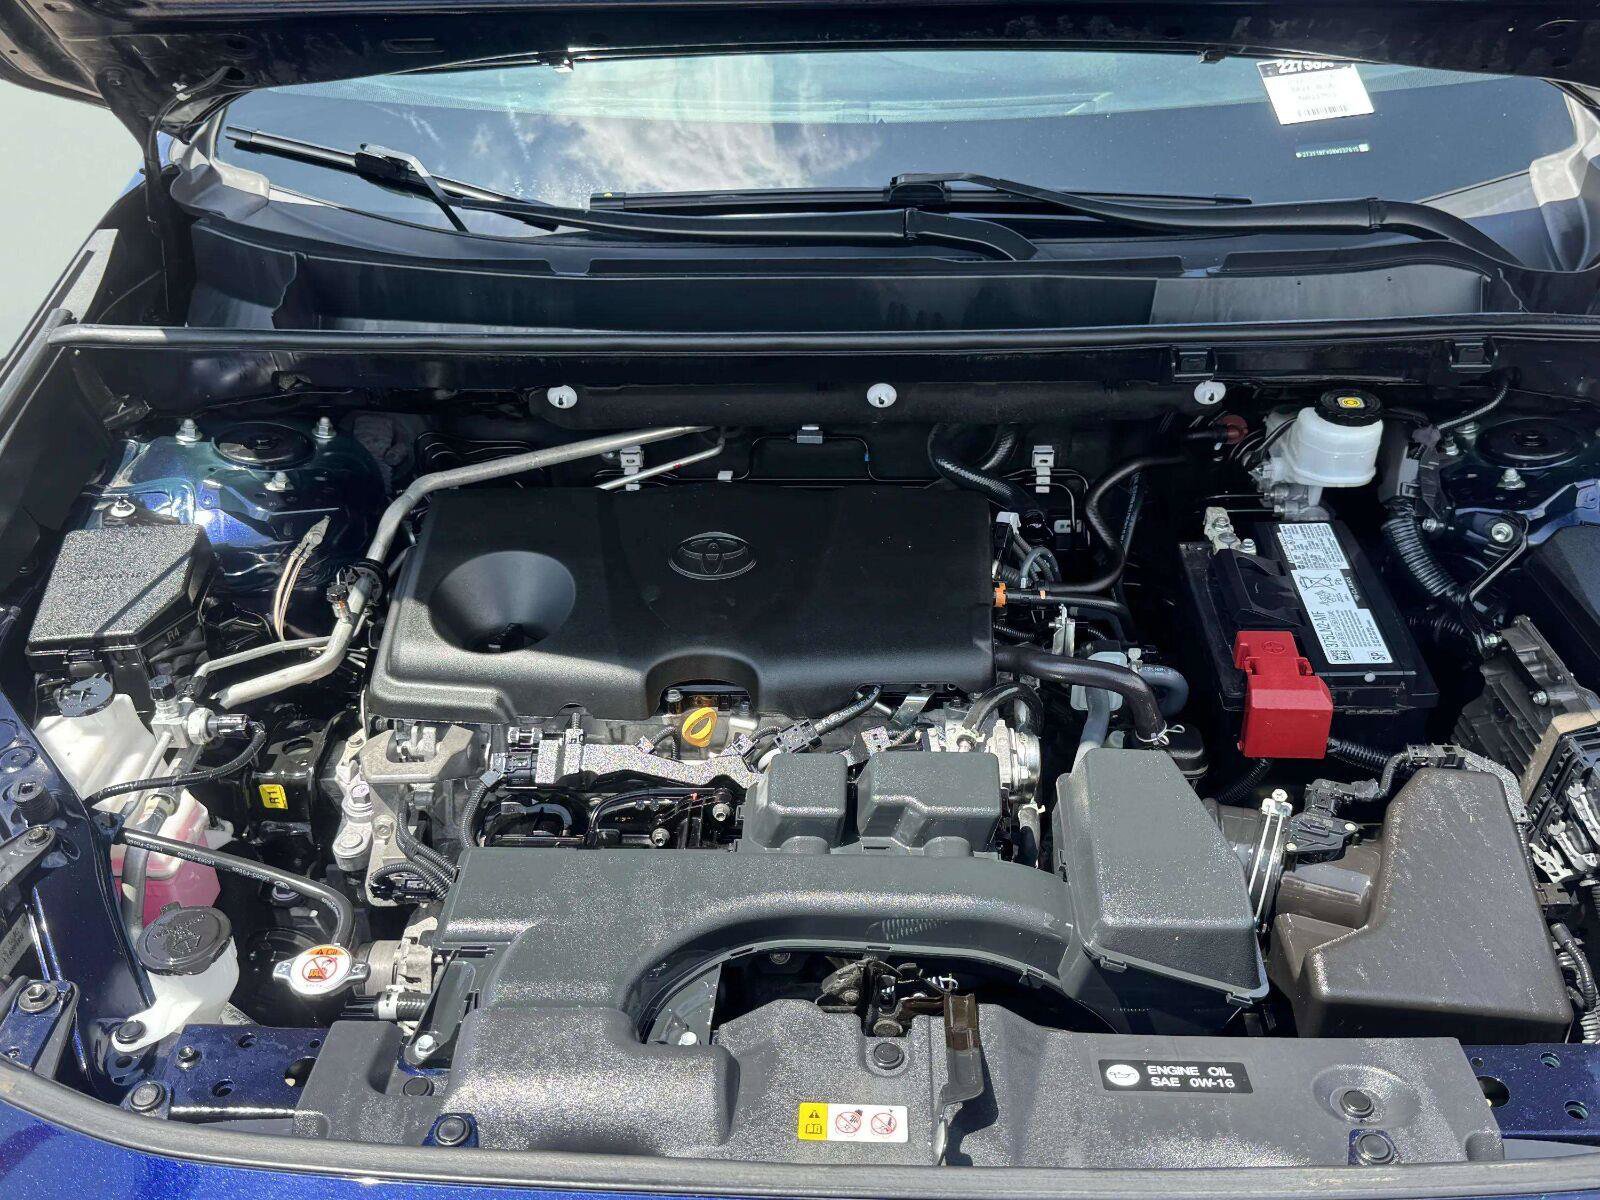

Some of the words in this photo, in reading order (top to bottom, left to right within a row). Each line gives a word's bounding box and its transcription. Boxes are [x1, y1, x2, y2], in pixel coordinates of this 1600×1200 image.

[1147, 1065, 1200, 1076] ENGINE
[1207, 1066, 1232, 1077] OIL
[1151, 1077, 1181, 1088] SAE
[1189, 1078, 1235, 1088] 0W-16
